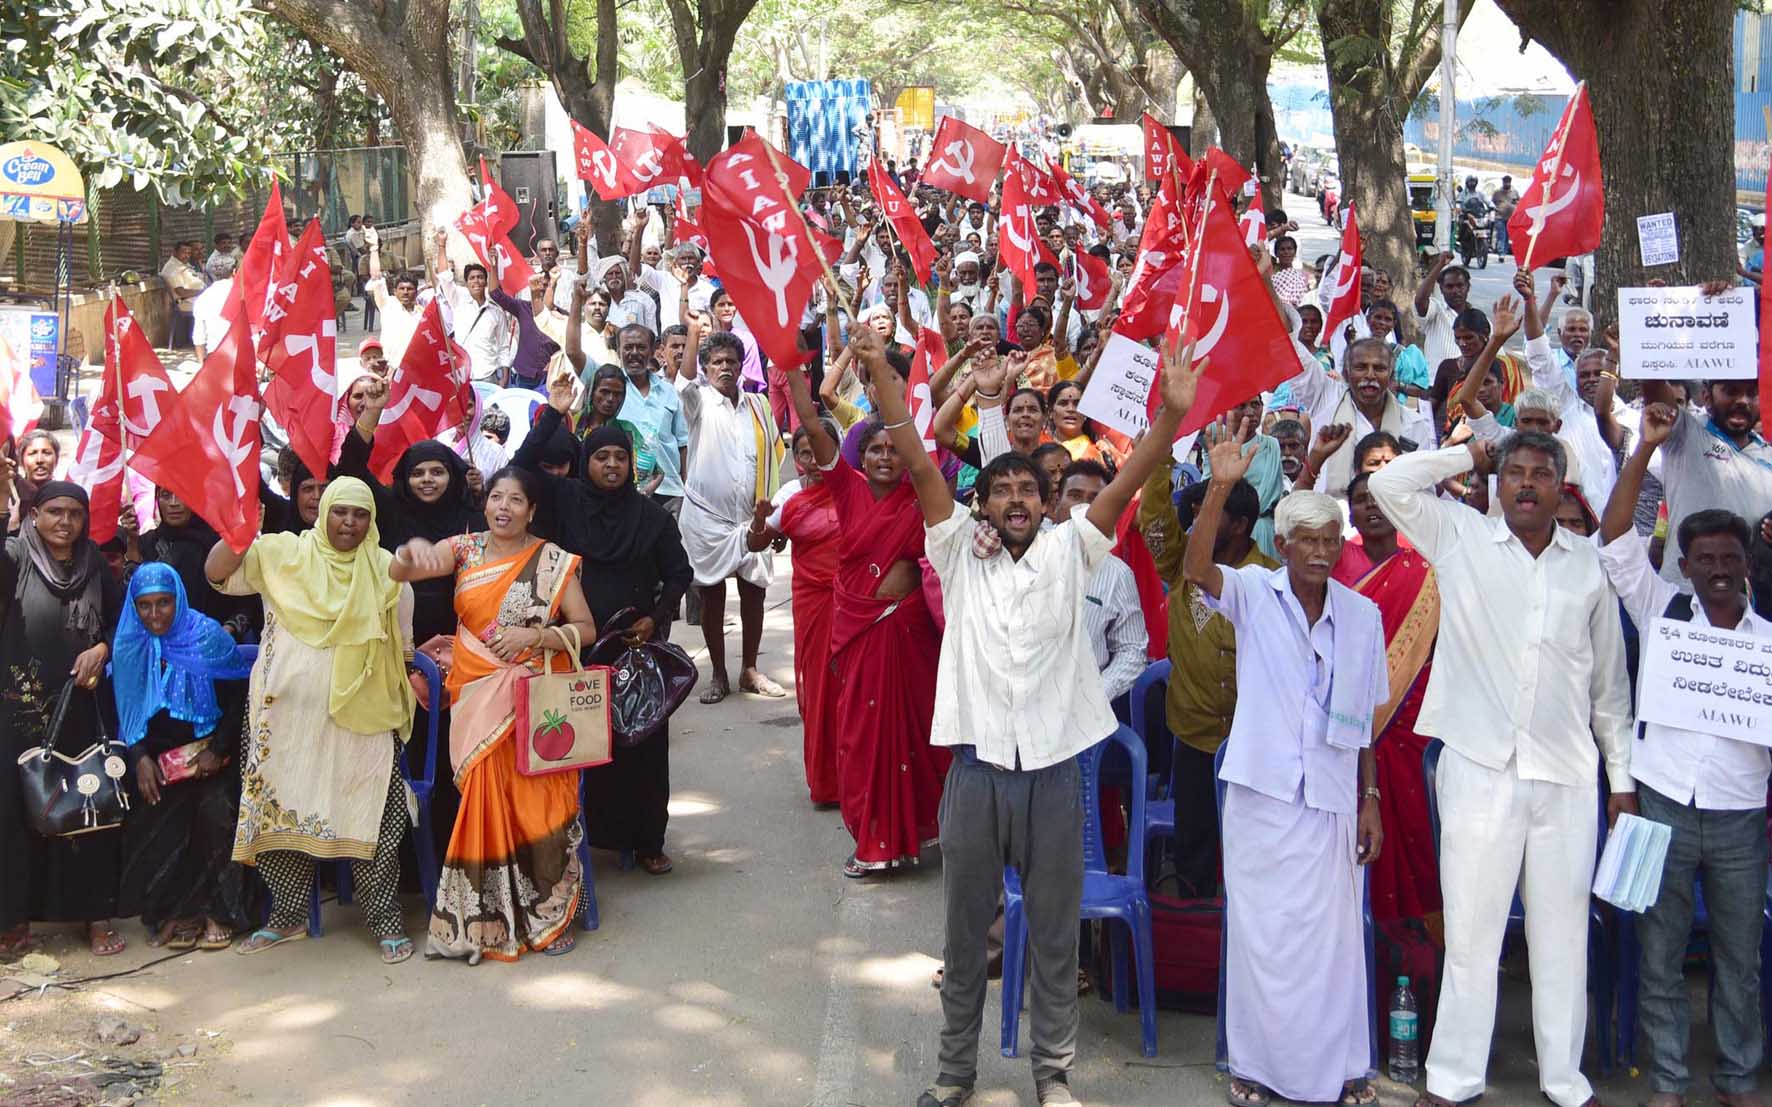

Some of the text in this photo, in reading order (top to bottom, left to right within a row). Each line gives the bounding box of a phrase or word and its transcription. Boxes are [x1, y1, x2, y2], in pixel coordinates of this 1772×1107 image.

[1151, 128, 1164, 177] IAWU
[8, 159, 49, 174] Cream
[16, 170, 41, 184] Bell
[1644, 311, 1729, 329] ಚುನಾವಣೆ
[1685, 357, 1736, 369] AIAWU
[1114, 407, 1148, 429] AIAW
[1671, 648, 1723, 669] ಉಚಿತ
[568, 679, 600, 693] LOVE
[570, 694, 602, 706] FOOD
[1698, 708, 1758, 729] AIAWU
